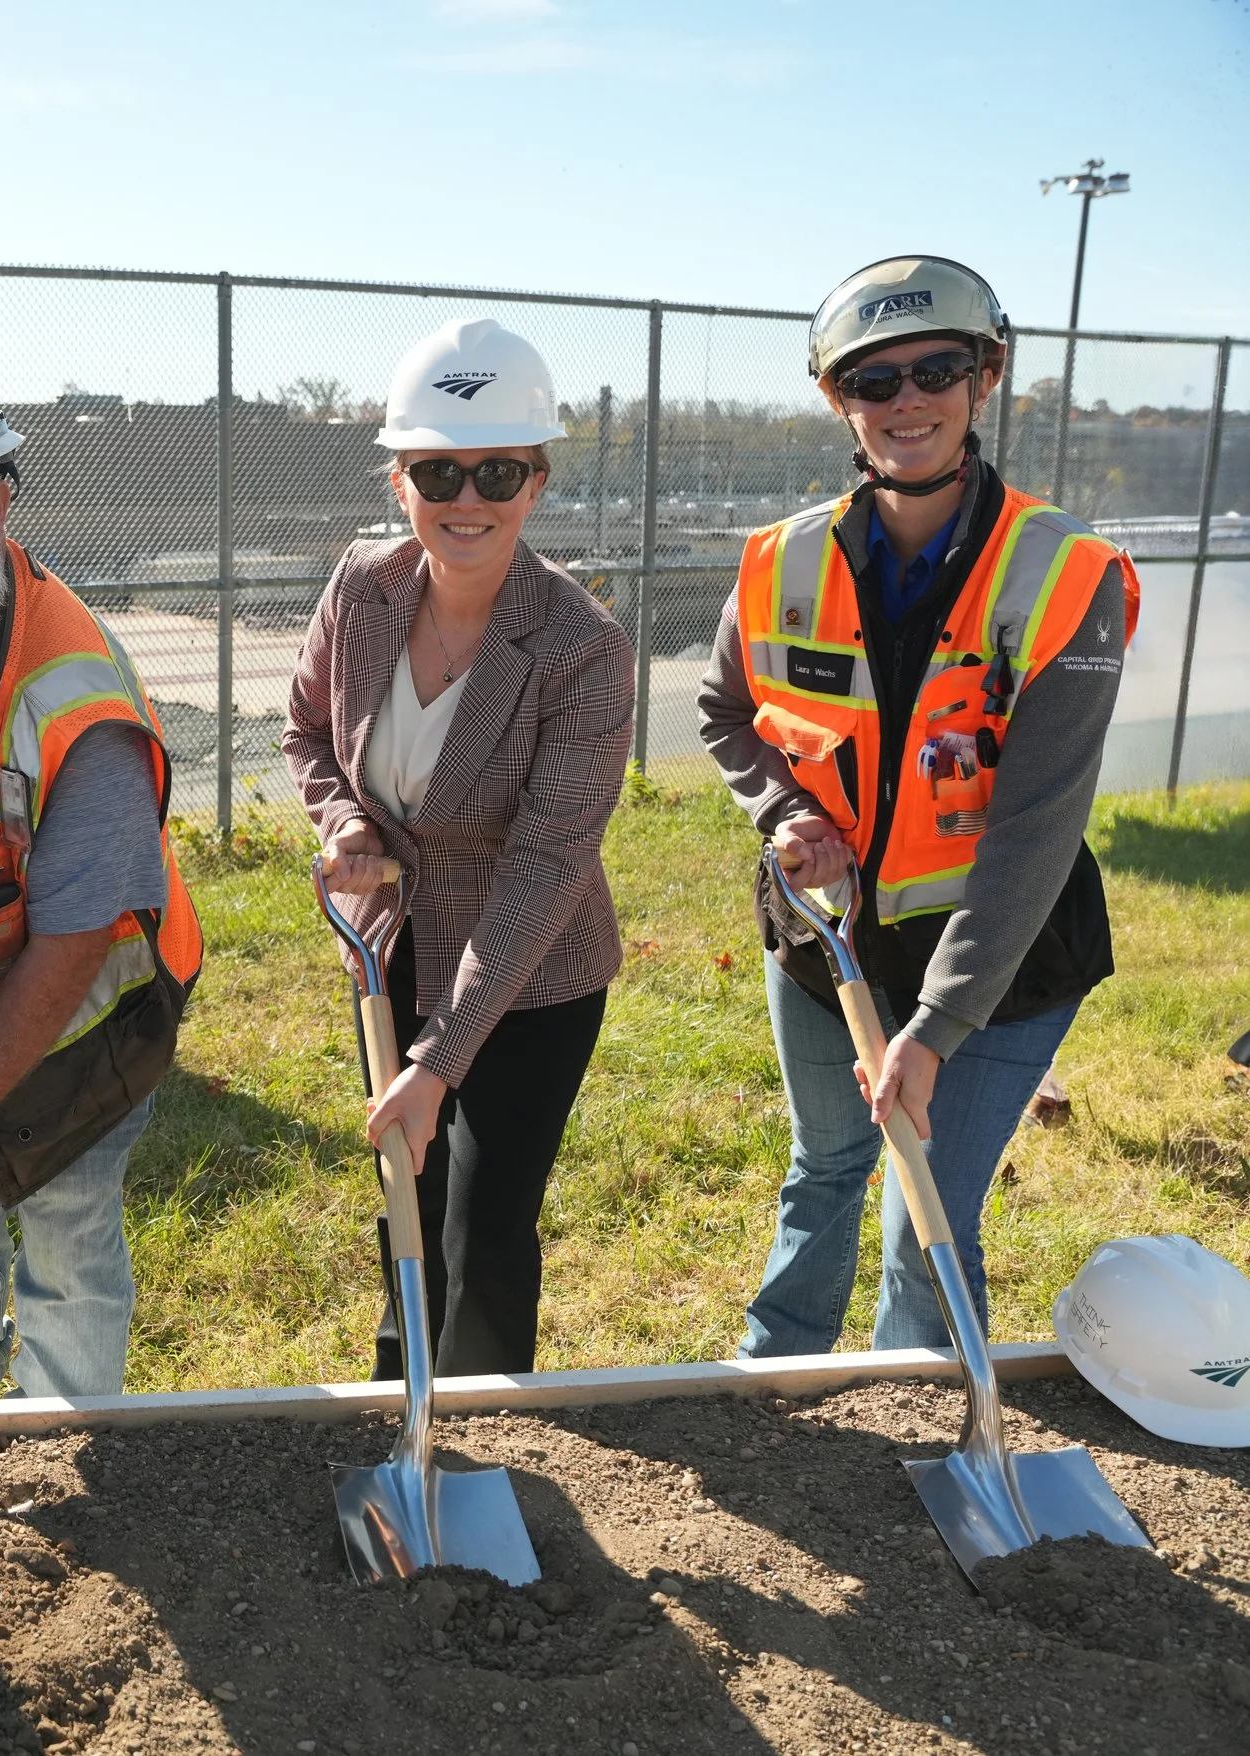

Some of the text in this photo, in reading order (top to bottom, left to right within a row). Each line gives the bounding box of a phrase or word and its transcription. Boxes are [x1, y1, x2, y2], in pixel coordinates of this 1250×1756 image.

[861, 294, 928, 319] CLARK
[795, 664, 836, 678] Laura Wachs
[1071, 1301, 1108, 1349] SAFETY
[1080, 1292, 1111, 1334] THINK
[1204, 1357, 1250, 1366] AMTRA
